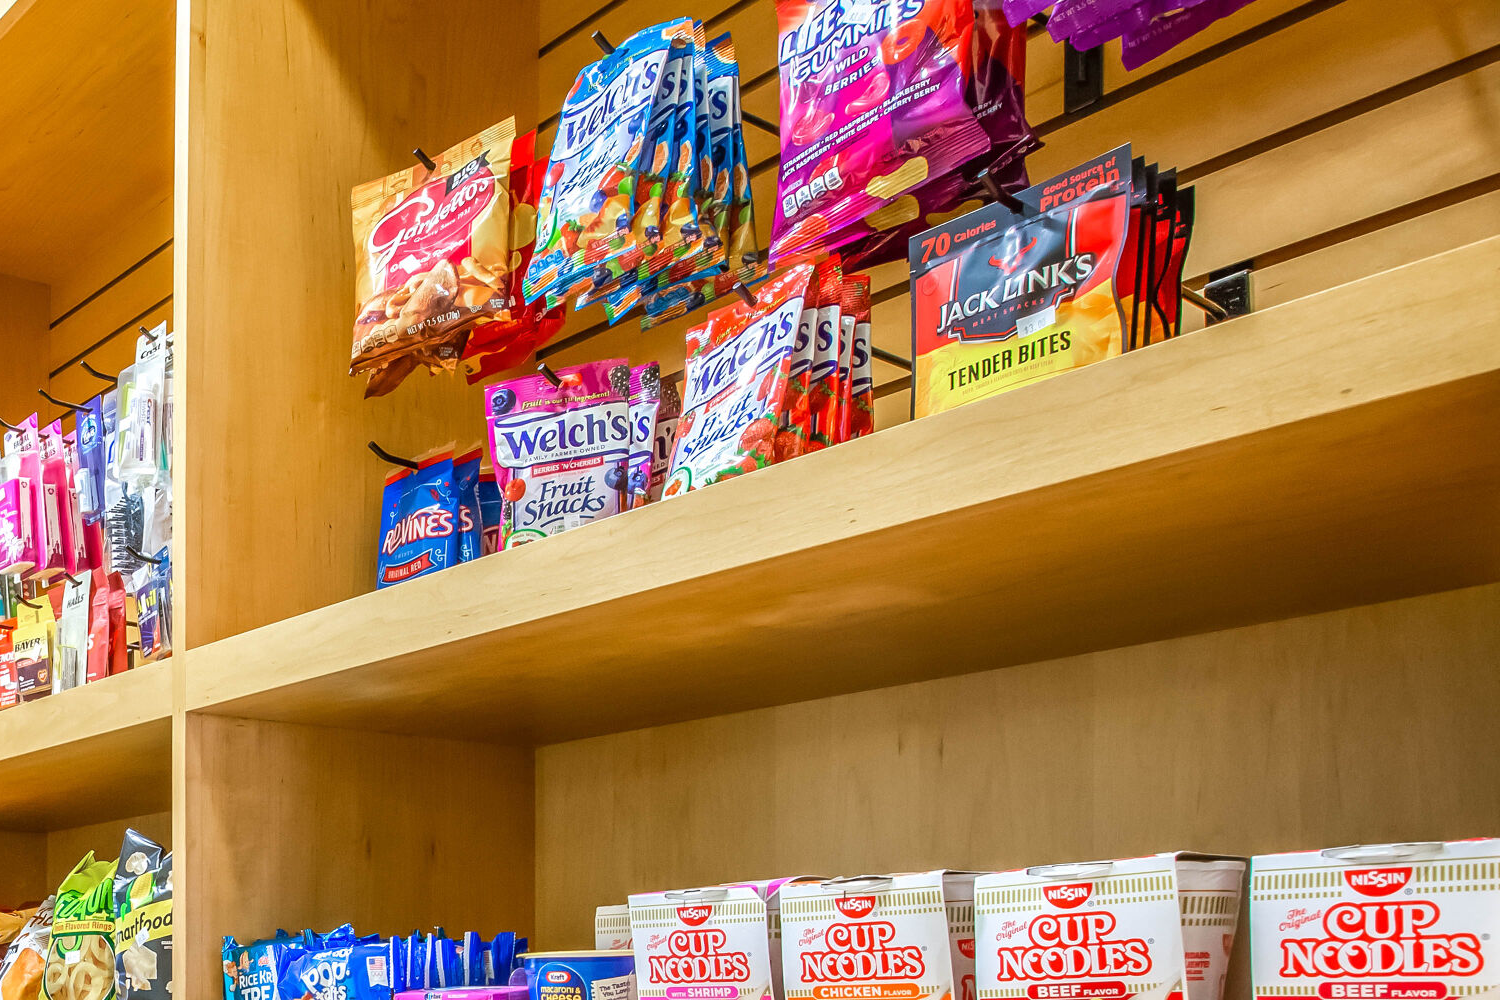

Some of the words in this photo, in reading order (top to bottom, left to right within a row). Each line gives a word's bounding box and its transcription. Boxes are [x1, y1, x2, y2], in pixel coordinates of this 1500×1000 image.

[1053, 14, 1067, 23] NET
[790, 0, 924, 84] GUMMIES
[835, 46, 869, 74] WILD
[824, 57, 878, 96] BERRIES
[565, 61, 658, 150] Welch's
[783, 143, 820, 170] STRAWBERRY
[825, 131, 838, 143] RED
[838, 107, 878, 136] RASPBERRY
[883, 79, 931, 108] BLACKBERRY
[795, 144, 831, 173] RASPBERRY
[835, 130, 856, 146] WHITE
[856, 116, 878, 134] GRAPE
[884, 96, 912, 116] CHERRY
[913, 82, 941, 102] BERRY
[452, 160, 477, 181] BIG
[1043, 178, 1068, 196] Good
[1069, 167, 1104, 187] Source
[1104, 157, 1116, 174] of
[1040, 167, 1120, 213] Protein
[921, 233, 951, 263] 70
[937, 287, 1000, 334] JACK
[1002, 253, 1094, 303] LINK'S
[972, 313, 998, 327] MEAT
[1003, 297, 1045, 315] SNACKS
[407, 325, 417, 335] NET
[437, 314, 446, 324] OZ
[141, 344, 160, 359] Crest
[692, 312, 794, 400] Welch's
[948, 349, 1012, 391] TENDER
[1018, 331, 1071, 365] BITES
[522, 400, 542, 410] Fruit
[501, 411, 628, 459] Welch's
[524, 455, 547, 464] FAMILY
[551, 450, 577, 458] FARMER
[580, 444, 605, 453] OWNED
[534, 464, 559, 474] BERRIES
[570, 458, 601, 468] CHERRIES
[539, 476, 595, 503] Fruit
[523, 493, 606, 526] Snacks
[388, 567, 409, 579] ORIGINAL
[411, 561, 422, 572] RED
[67, 594, 84, 608] HALLS
[15, 638, 40, 652] BAYER
[1351, 872, 1405, 887] NISSIN
[1048, 887, 1087, 900] NISSIN
[680, 908, 708, 919] NISSIN
[840, 900, 872, 911] NISSIN
[1287, 908, 1307, 919] The
[65, 923, 90, 931] Flavored
[92, 921, 112, 931] Rings
[1002, 920, 1016, 931] The
[1029, 912, 1116, 946] CUP
[1279, 910, 1323, 931] Original
[1323, 901, 1440, 939] CUP
[650, 933, 660, 944] The
[799, 930, 824, 947] Original
[803, 927, 815, 938] The
[826, 922, 895, 953] CUP
[996, 922, 1027, 941] Original
[647, 936, 667, 950] Original
[669, 929, 726, 957] CUP
[801, 947, 926, 982] NOODLES
[998, 939, 1152, 981] NOODLES
[1280, 933, 1483, 977] NOODLES
[550, 973, 565, 981] Kraft
[650, 952, 750, 983] NOODLES
[239, 972, 258, 989] RICE
[541, 986, 574, 994] macaroni
[612, 981, 630, 989] Taste
[688, 988, 731, 998] SHRIMP
[821, 987, 881, 998] CHICKEN
[1037, 985, 1081, 998] BEEF
[1331, 984, 1388, 998] BEEF
[1391, 990, 1436, 998] FLAVOR
